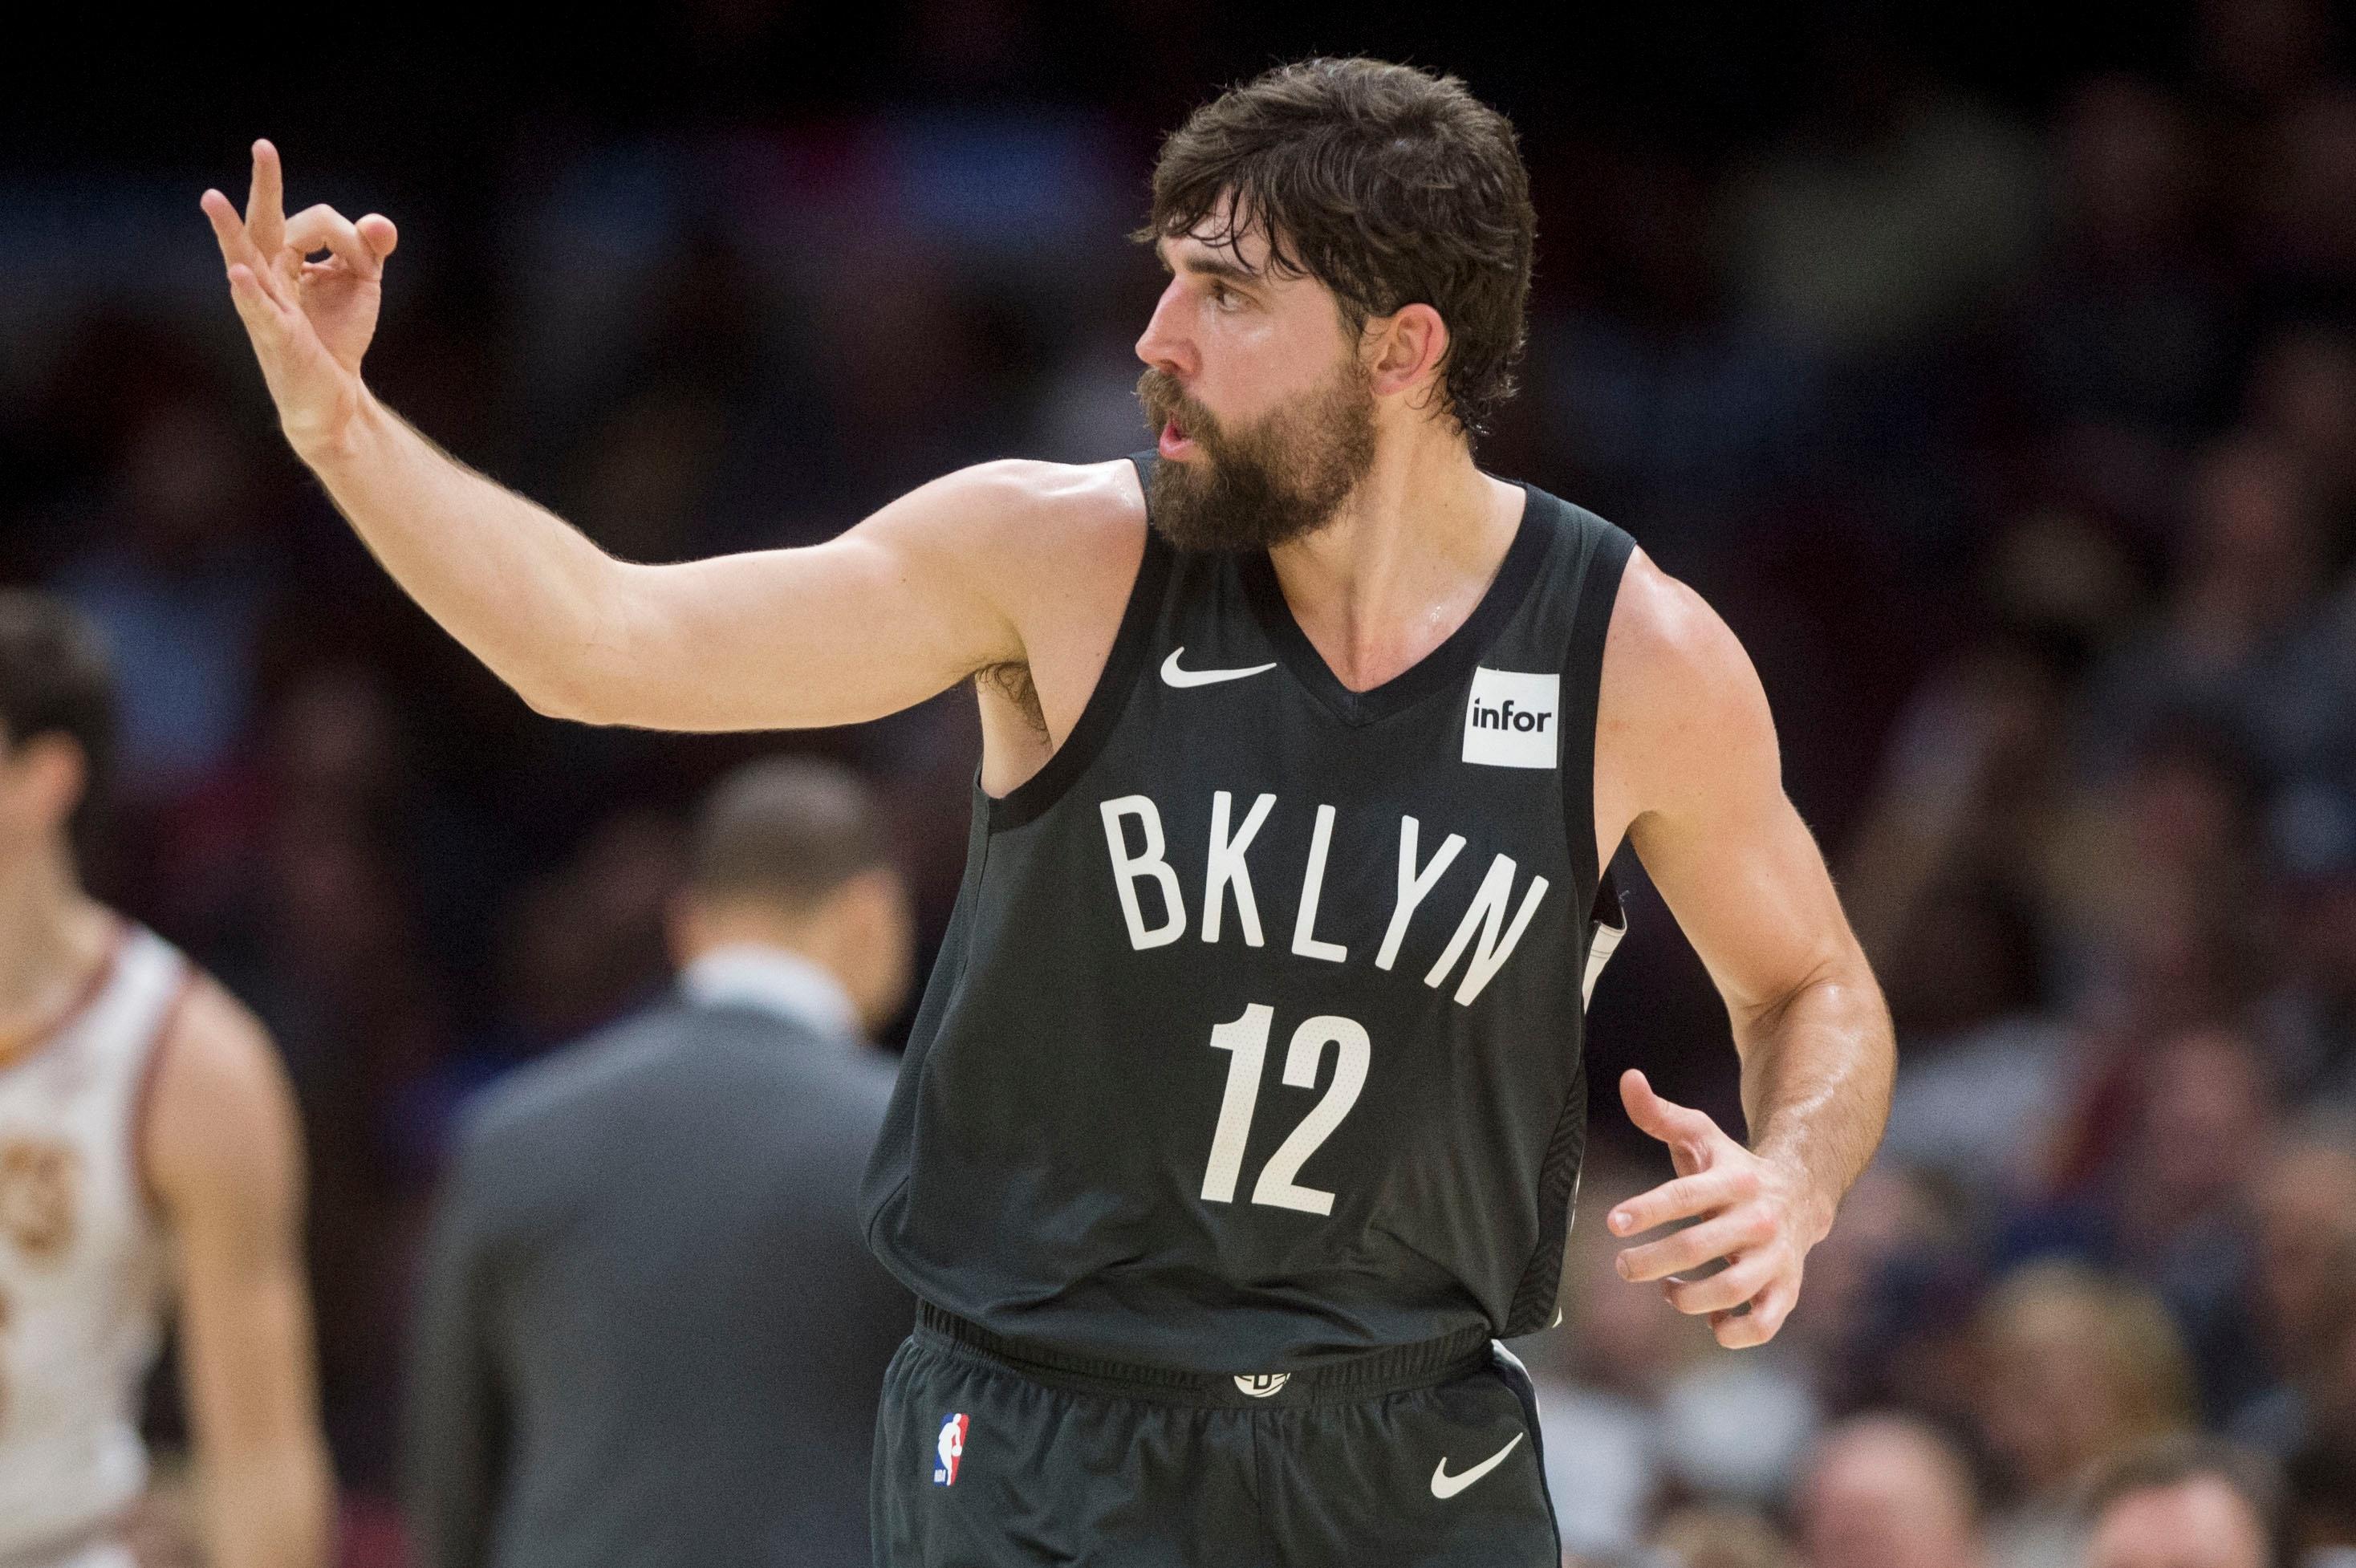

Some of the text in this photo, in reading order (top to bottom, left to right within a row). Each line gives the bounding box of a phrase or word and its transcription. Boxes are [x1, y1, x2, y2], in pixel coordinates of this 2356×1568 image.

[1472, 697, 1551, 733] infor
[1099, 790, 1550, 1007] BKLYN
[1200, 1003, 1371, 1217] 12
